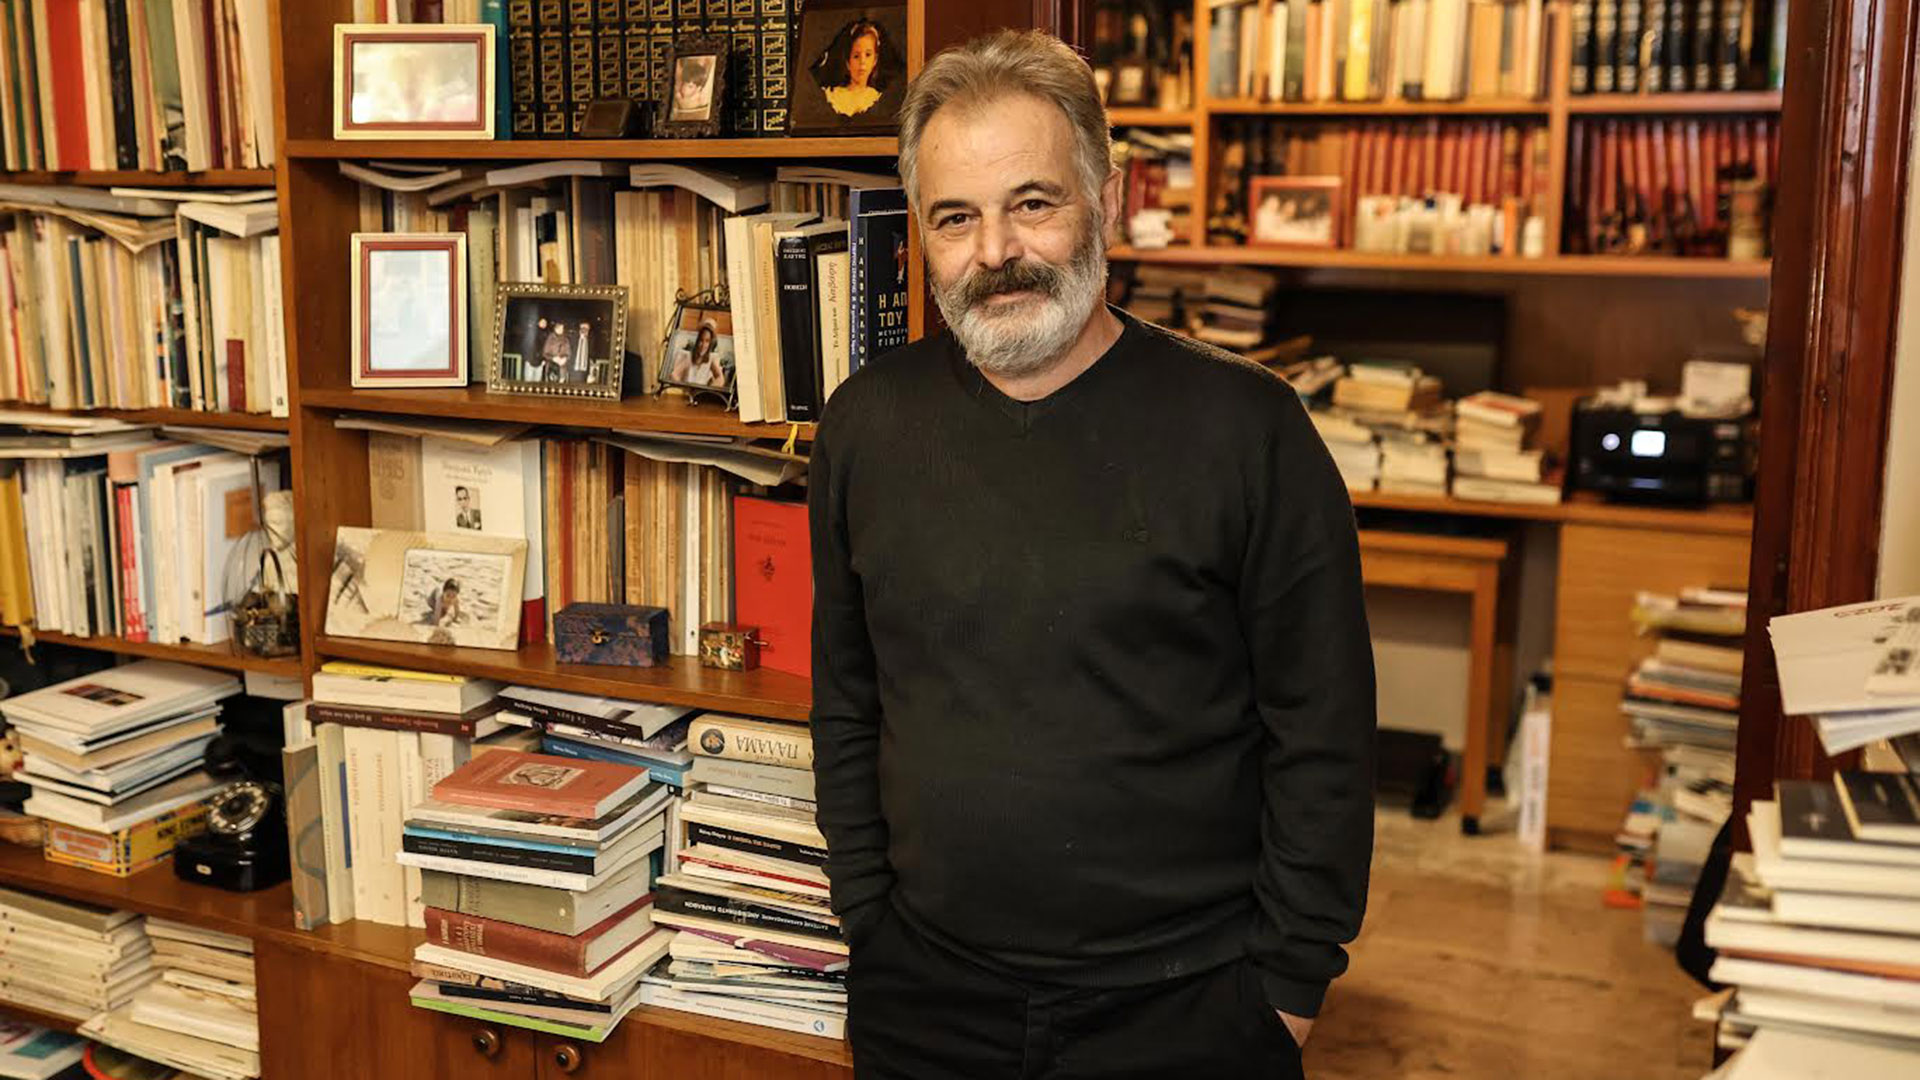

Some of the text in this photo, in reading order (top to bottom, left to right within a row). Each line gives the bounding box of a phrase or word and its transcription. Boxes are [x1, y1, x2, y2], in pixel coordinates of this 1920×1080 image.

[878, 293, 887, 309] Η
[878, 310, 903, 327] ΤΟΥ
[735, 735, 799, 760] ΠΑΛΑΜΑ
